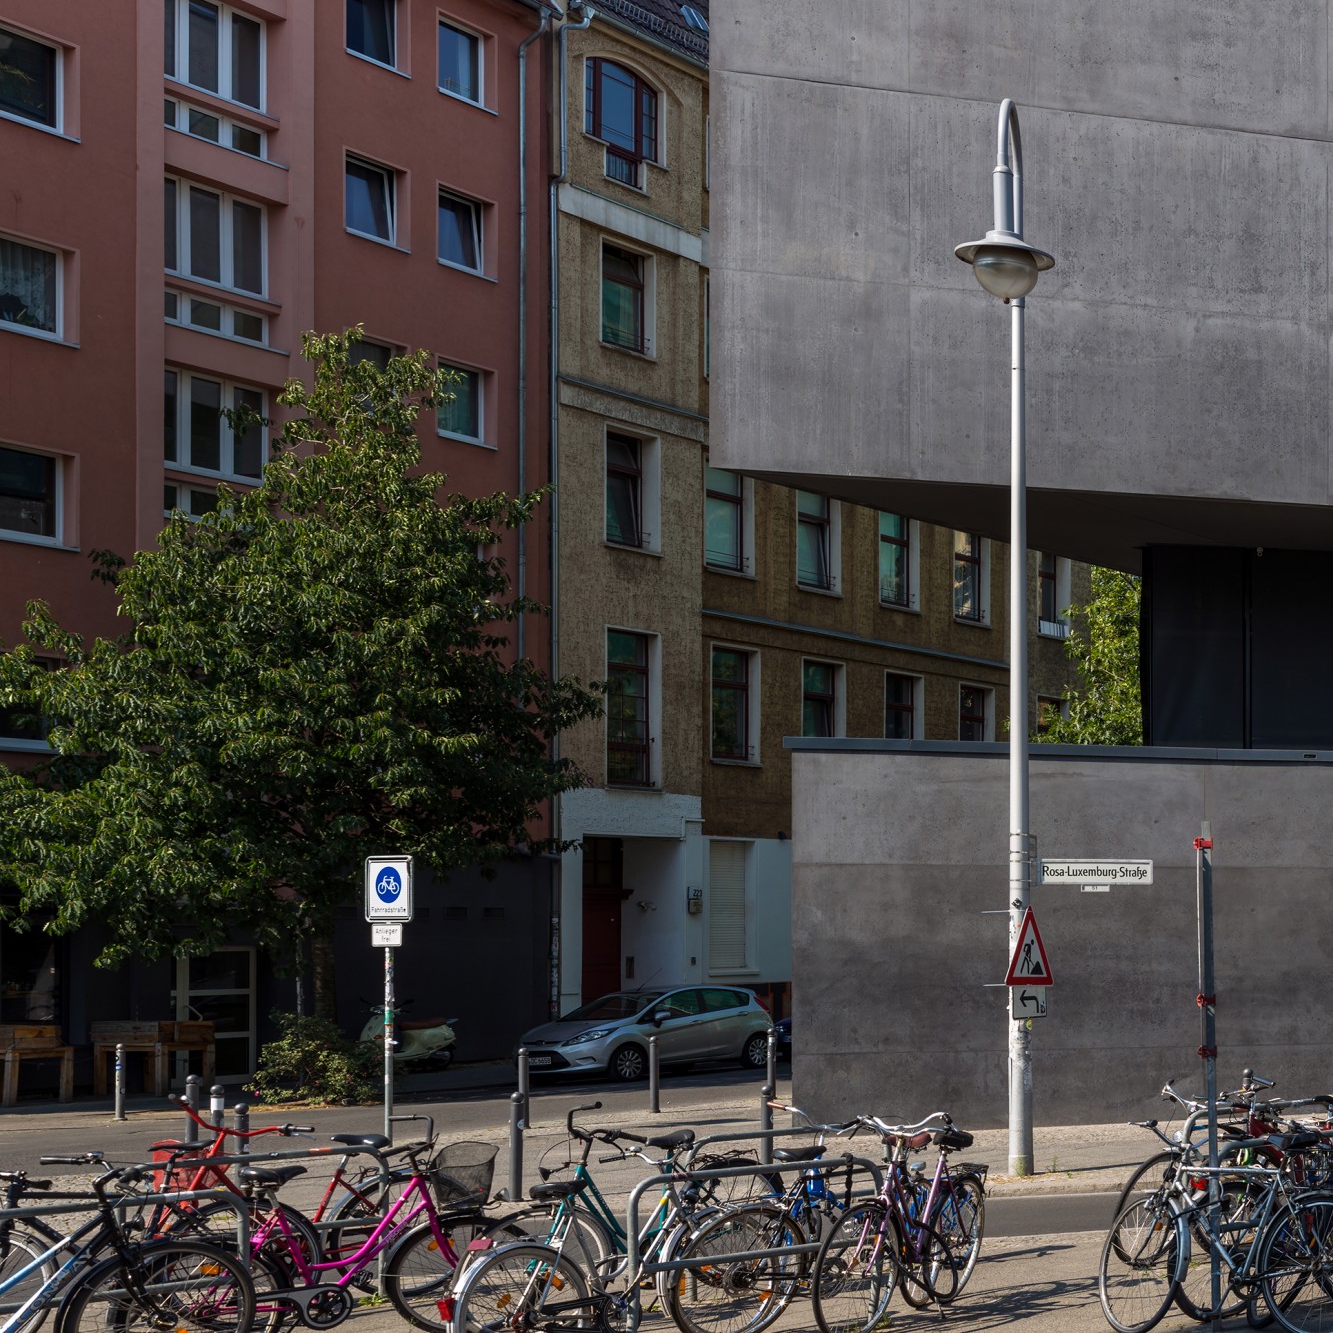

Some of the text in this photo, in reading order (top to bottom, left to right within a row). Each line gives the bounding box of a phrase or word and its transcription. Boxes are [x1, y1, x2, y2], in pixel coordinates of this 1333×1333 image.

[1042, 865, 1148, 879] Rosa-Luxemburg-Straße
[692, 889, 703, 897] 223
[371, 906, 407, 914] Fahrradstraße
[375, 928, 398, 936] Anlieger
[16, 1247, 93, 1324] CONAY
